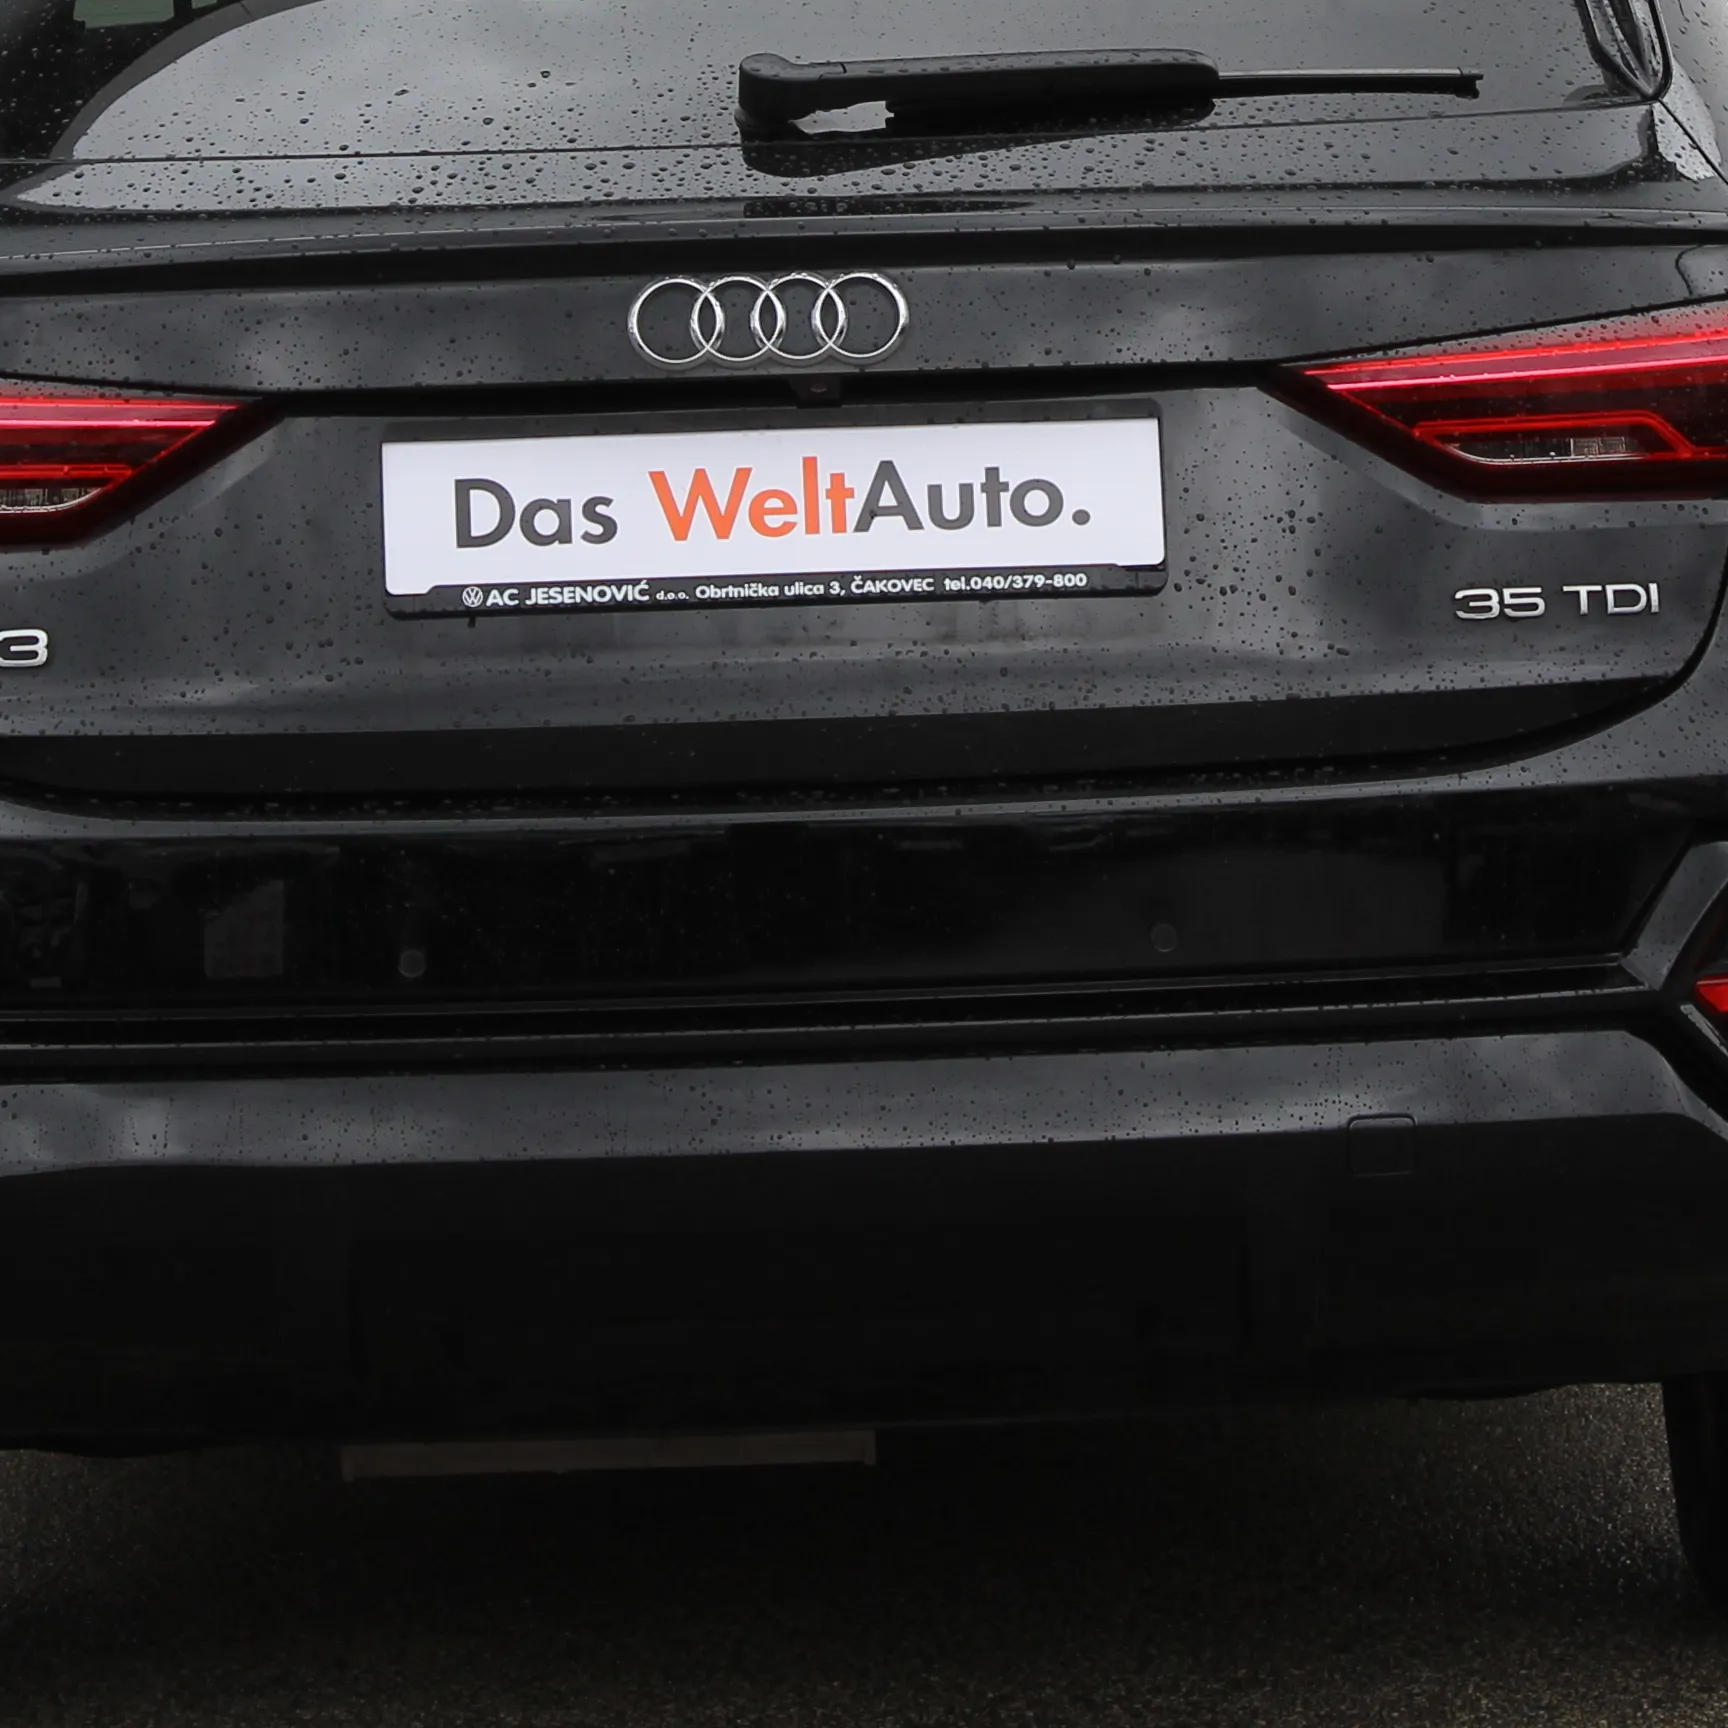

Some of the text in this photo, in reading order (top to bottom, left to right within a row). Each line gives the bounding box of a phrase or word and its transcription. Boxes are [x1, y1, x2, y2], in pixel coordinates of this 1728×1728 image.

[454, 456, 1092, 549] Das WeltAuto.
[485, 587, 520, 607] AC
[524, 578, 651, 606] JESENOVIĆ
[655, 590, 690, 601] d.o.o.
[695, 580, 780, 600] Obrtnička
[783, 580, 825, 596] ulica
[828, 579, 847, 597] 3,
[850, 573, 935, 594] ČAKOVEC
[943, 572, 1088, 591] tel.040/379-800
[1454, 582, 1660, 620] 35 TDI
